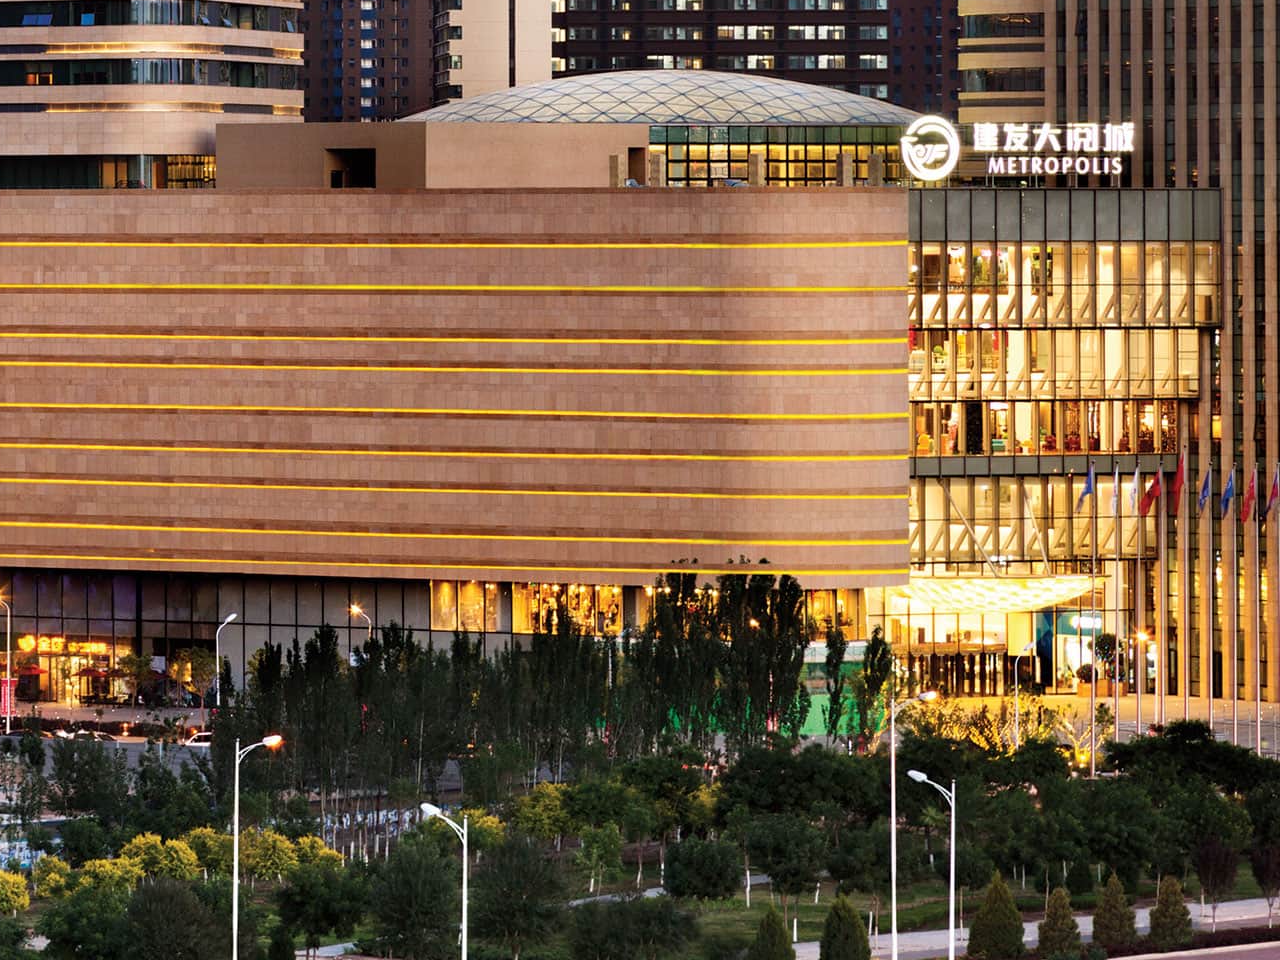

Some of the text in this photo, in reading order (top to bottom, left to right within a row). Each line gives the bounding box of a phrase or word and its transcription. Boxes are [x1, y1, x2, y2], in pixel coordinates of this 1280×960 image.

[973, 122, 1136, 152] 建发大阅城
[988, 156, 1123, 175] METROPOLIS
